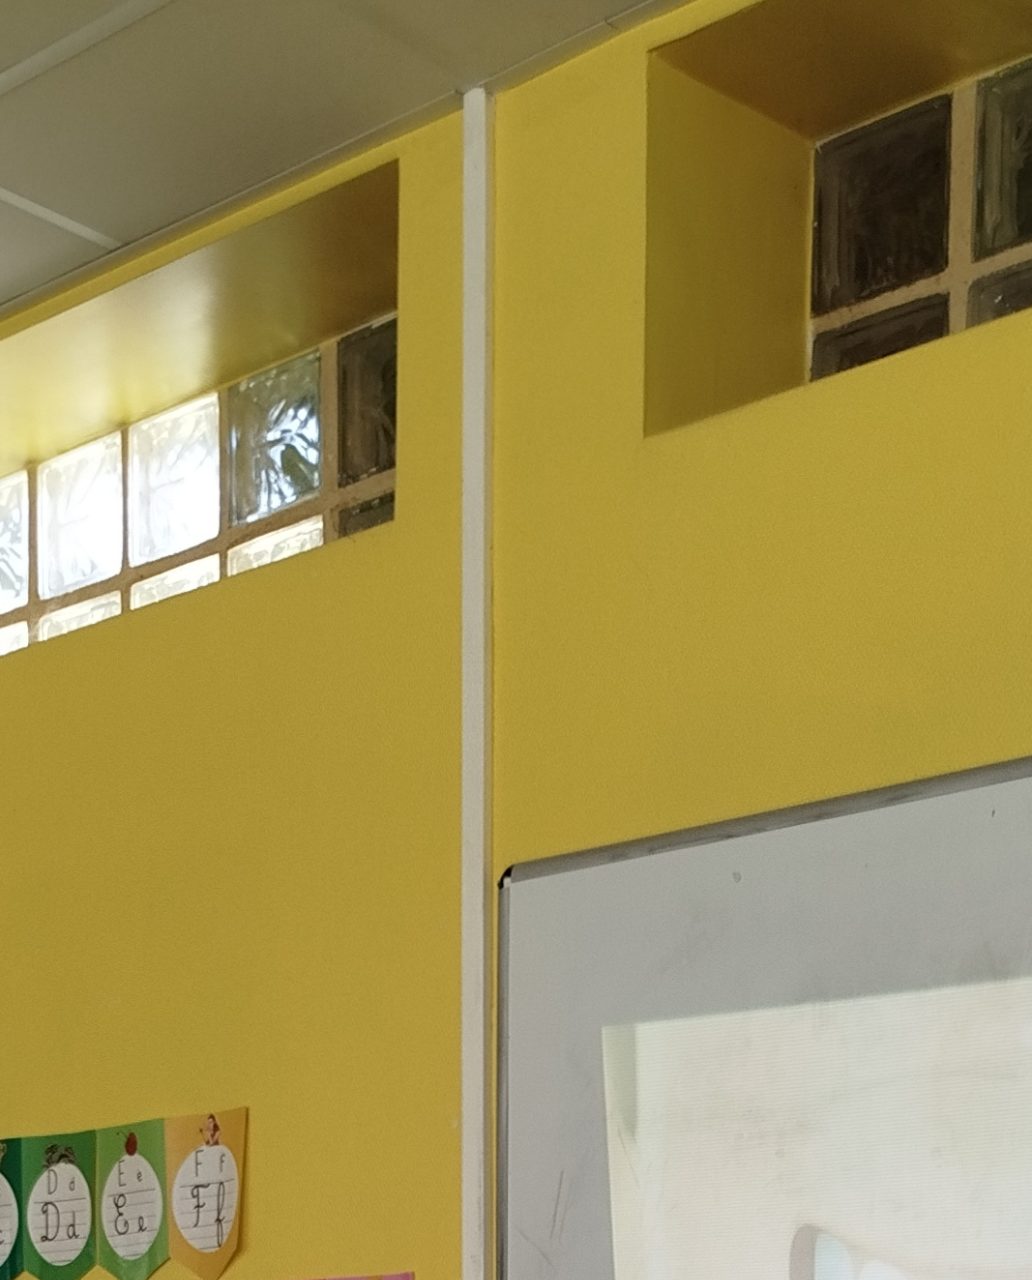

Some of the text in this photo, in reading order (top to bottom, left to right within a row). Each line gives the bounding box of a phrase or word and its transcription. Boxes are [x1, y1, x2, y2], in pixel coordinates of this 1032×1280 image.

[118, 1160, 126, 1186] E
[196, 1150, 204, 1177] F
[48, 1169, 58, 1195] D
[41, 1201, 60, 1242] D
[67, 1211, 79, 1239] d
[114, 1194, 147, 1236] E e
[191, 1182, 225, 1247] F f
